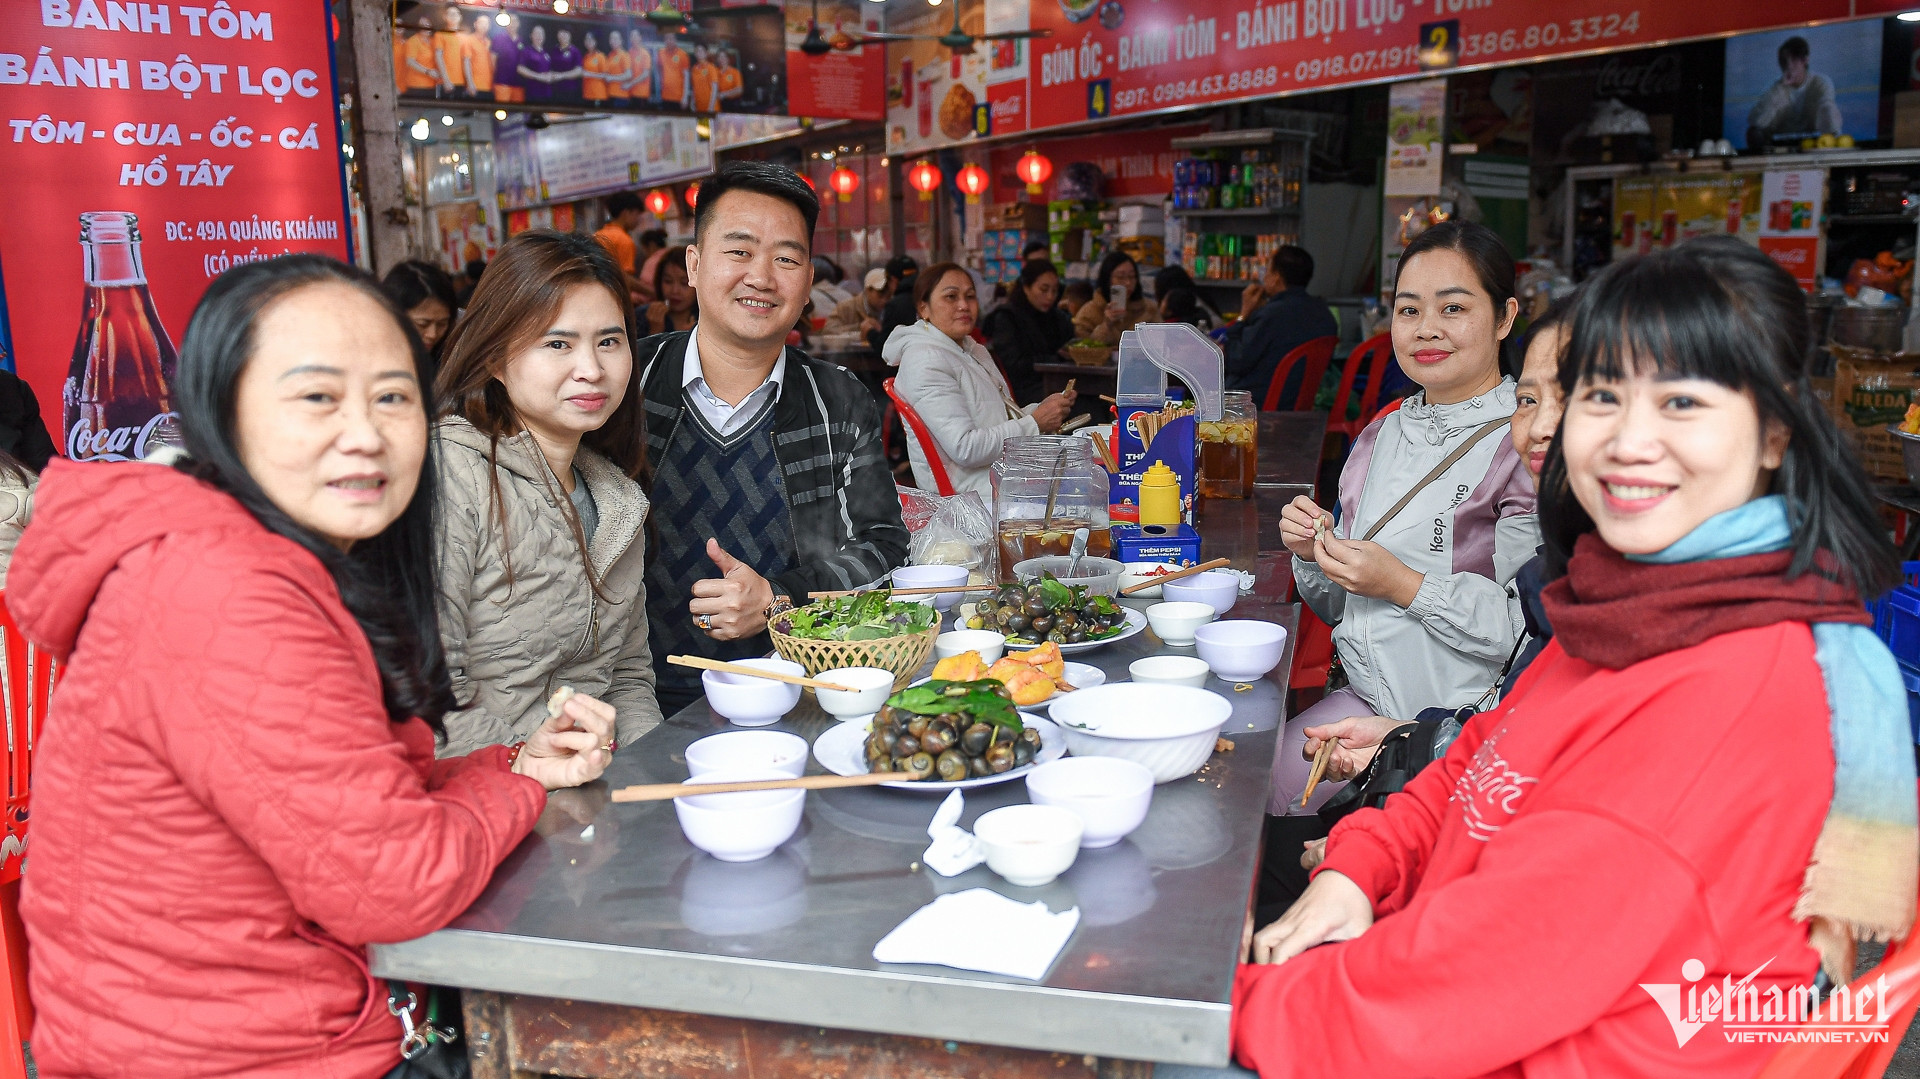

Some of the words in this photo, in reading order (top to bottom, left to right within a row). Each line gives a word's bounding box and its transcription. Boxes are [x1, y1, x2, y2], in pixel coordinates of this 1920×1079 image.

[179, 0, 273, 41] TÔM
[1041, 43, 1075, 87] BÚN
[1080, 31, 1102, 79] ỐC
[1118, 25, 1168, 71] BÁNH
[1174, 13, 1216, 60] TÔM
[1236, 0, 1297, 50] BÁNH
[1430, 26, 1449, 66] 2
[0, 45, 131, 89] BÁNH
[139, 53, 228, 99] BỘT
[237, 65, 319, 103] LỌC
[1114, 87, 1148, 109] SĐT:
[1153, 65, 1277, 103] 0984.63.8888
[1092, 84, 1105, 114] 4
[9, 114, 85, 144] TÔM
[113, 122, 182, 147] CUA
[210, 116, 253, 148] ỐC
[278, 122, 319, 150] CÁ
[119, 153, 168, 186] HỒ
[176, 158, 234, 186] TÂY
[165, 221, 193, 242] ĐC:
[196, 220, 228, 241] 49A
[229, 214, 282, 242] QUẢNG
[285, 215, 338, 240] KHÁNH
[1430, 518, 1446, 552] Keep
